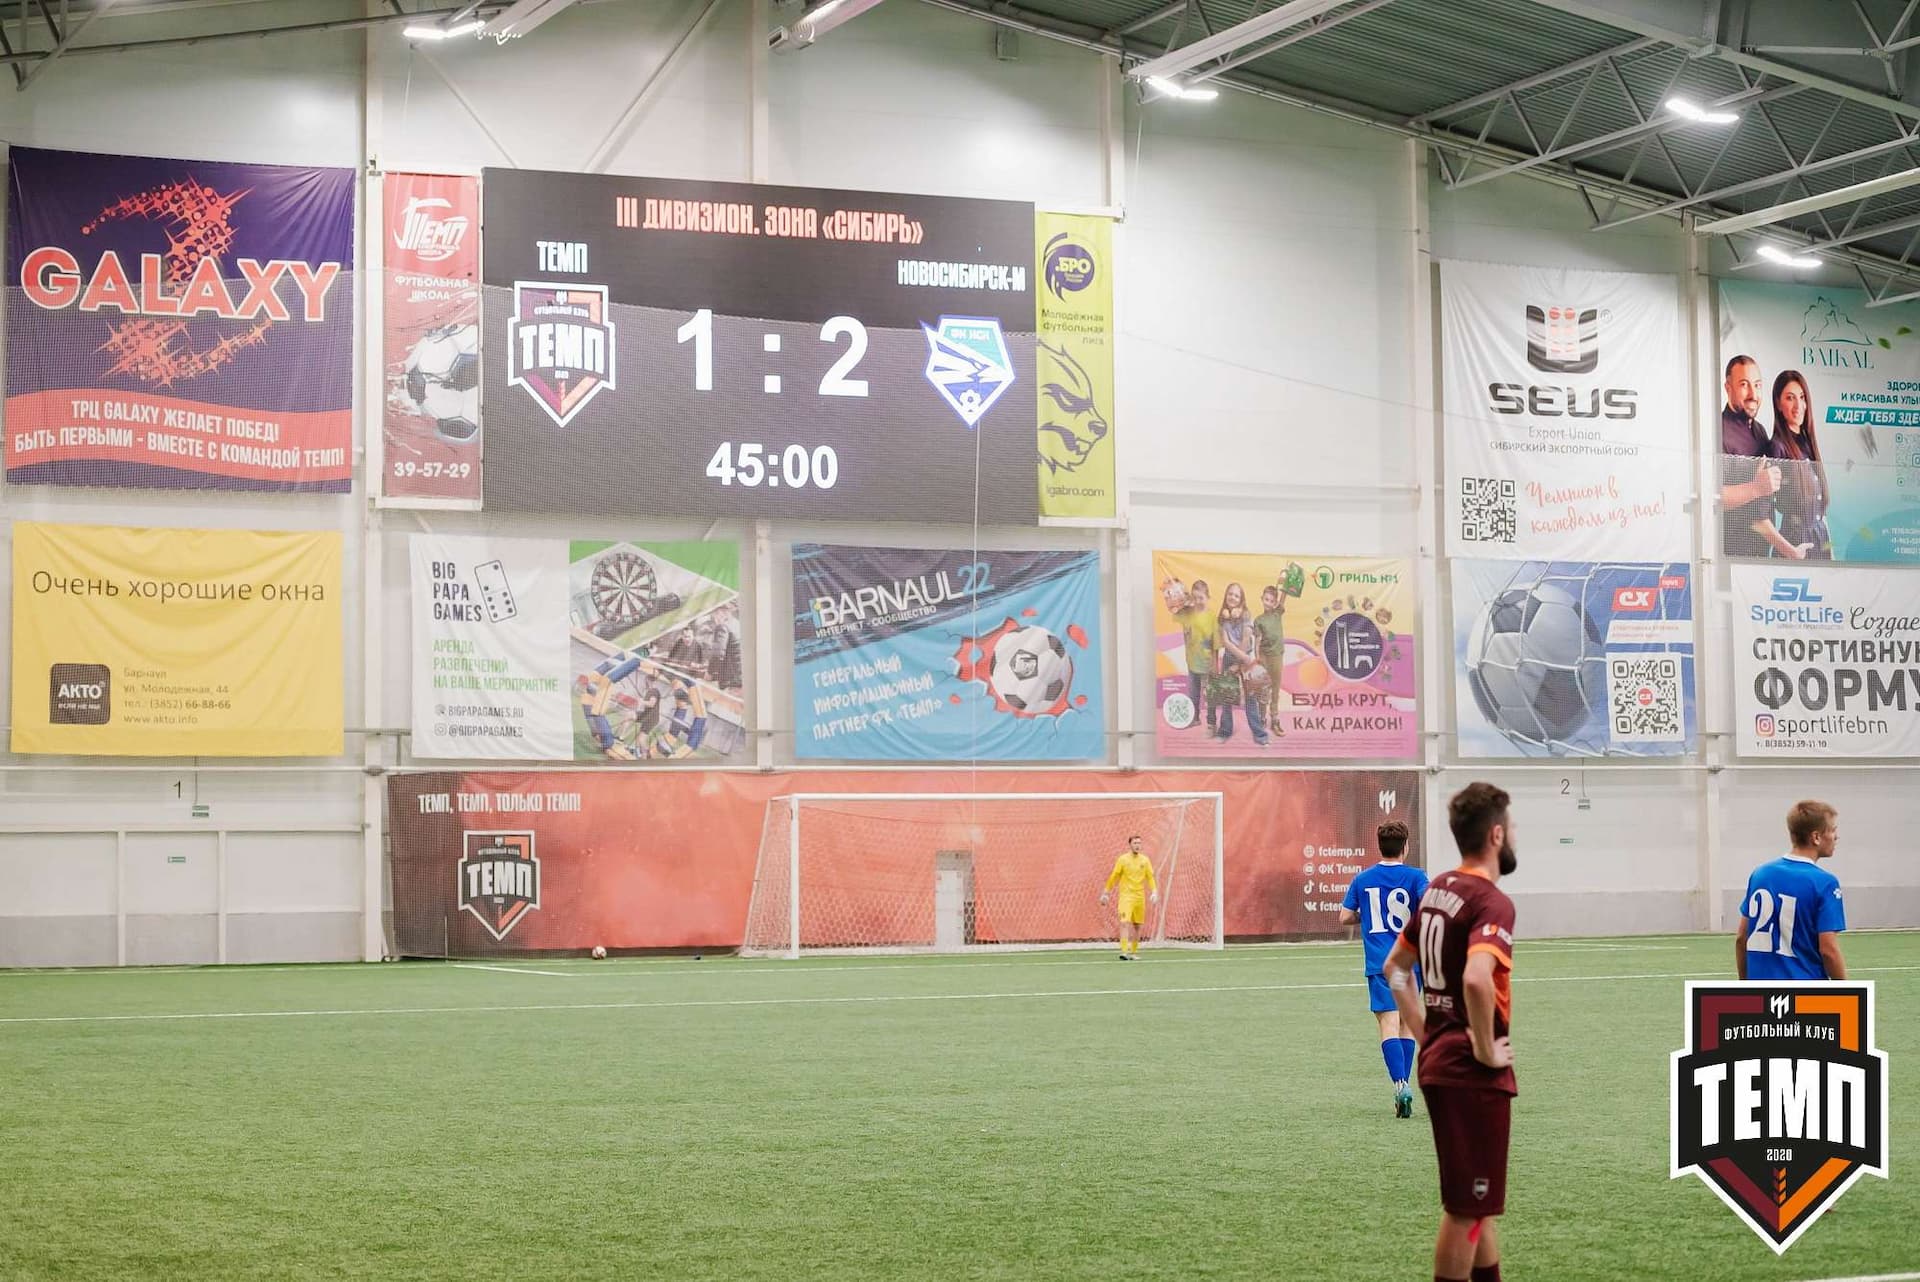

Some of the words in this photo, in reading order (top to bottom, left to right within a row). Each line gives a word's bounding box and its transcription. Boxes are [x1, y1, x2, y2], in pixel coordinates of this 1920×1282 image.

[616, 196, 637, 228] III
[642, 198, 760, 235] ДИВИЗИОН.
[764, 205, 817, 238] ЗОНА
[822, 210, 924, 244] «СИБИРЬ»
[536, 240, 588, 273] ТЕМП
[21, 247, 340, 321] GALAXY
[394, 275, 469, 288] ФУТБОЛЬНАЯ
[897, 259, 1026, 291] НОВОСИБИРСК-М
[411, 289, 450, 301] ШКОЛА
[518, 322, 605, 375] ТЕМП
[677, 308, 712, 391] 1
[818, 315, 869, 397] 2
[1488, 382, 1638, 420] SEUS
[1841, 392, 1848, 401] И
[1850, 393, 1899, 404] КРАСИВАЯ
[71, 400, 100, 421] ТРЦ
[104, 402, 161, 424] GALAXY
[163, 407, 222, 435] ЖЕЛАЕТ
[226, 419, 280, 443] ПОБЕД!
[1834, 409, 1867, 424] ЖДЕТ
[1869, 411, 1896, 424] ТЕБЯ
[1898, 412, 1920, 426] ЗДЕ
[15, 431, 56, 453] БЫТЬ
[59, 426, 133, 448] ПЕРВЫМИ
[147, 432, 203, 458] ВМЕСТЕ
[208, 446, 217, 460] С
[221, 446, 301, 469] КОМАНДОЙ
[304, 448, 345, 468] ТЕМП!
[1490, 440, 1546, 453] СИБИРСКИЙ
[1548, 443, 1612, 456] ЭКСПОРТНЫЙ
[1613, 446, 1640, 456] СОЮЗ
[394, 462, 471, 479] 39-57-29
[706, 441, 839, 489] 45:00
[1525, 481, 1604, 508] Чемпион
[1531, 506, 1606, 534] каждом
[1608, 505, 1630, 528] из
[1633, 491, 1667, 517] нас!
[432, 561, 456, 579] BIG
[1340, 573, 1378, 583] ГРИЛЬ
[32, 570, 119, 597] Очень
[128, 580, 252, 603] хорошие
[261, 582, 325, 601] окна
[433, 582, 470, 601] PAPA
[815, 570, 963, 627] BARNAUL
[957, 562, 995, 595] 22
[1770, 578, 1823, 602] SL
[433, 602, 482, 622] GAMES
[815, 620, 864, 638] ИНТЕРНЕТ
[871, 605, 937, 627] СООБЩЕСТВО
[1751, 605, 1844, 624] SportLife
[433, 640, 475, 654] АРЕНДА
[124, 668, 167, 679] Барнаул
[433, 656, 509, 673] РАЗВЛЕЧЕНИЙ
[813, 653, 902, 688] ГЕНЕРАЛЬНЫЙ
[58, 684, 102, 700] АКТО
[216, 686, 229, 694] 44
[433, 675, 448, 689] НА
[451, 676, 481, 690] ВАШЕ
[483, 678, 559, 693] МЕРОПРИЯТИЕ
[813, 670, 934, 716] ИНФОРМАЦИОННЫЙ
[149, 700, 183, 710] (3852)
[185, 700, 231, 710] 66-88-66
[1292, 693, 1344, 709] БУДЬ
[1348, 693, 1393, 709] КРУТ,
[124, 715, 198, 725] www.akto.info
[448, 704, 524, 718] BIGPAPAGAMES.RU
[448, 724, 524, 738] @BIGPAPAGAMES
[812, 713, 869, 741] ПАРТНЕР
[872, 708, 893, 727] ФК
[1293, 717, 1326, 730] КАК
[1330, 717, 1402, 733] ДРАКОН!
[1778, 716, 1888, 737] sportlifebrn
[174, 780, 181, 799] 1
[1561, 779, 1570, 794] 2
[418, 794, 453, 814] ТЕМП,
[457, 793, 493, 814] ТЕМП,
[495, 793, 543, 813] ТОЛЬКО
[546, 793, 581, 812] ТЕМП!
[1318, 846, 1366, 858] fctemp.ru
[1318, 863, 1334, 874] ФК
[467, 861, 532, 898] ТЕМП
[1364, 887, 1411, 934] 18
[1746, 888, 1798, 957] 21
[1419, 912, 1446, 991] 10
